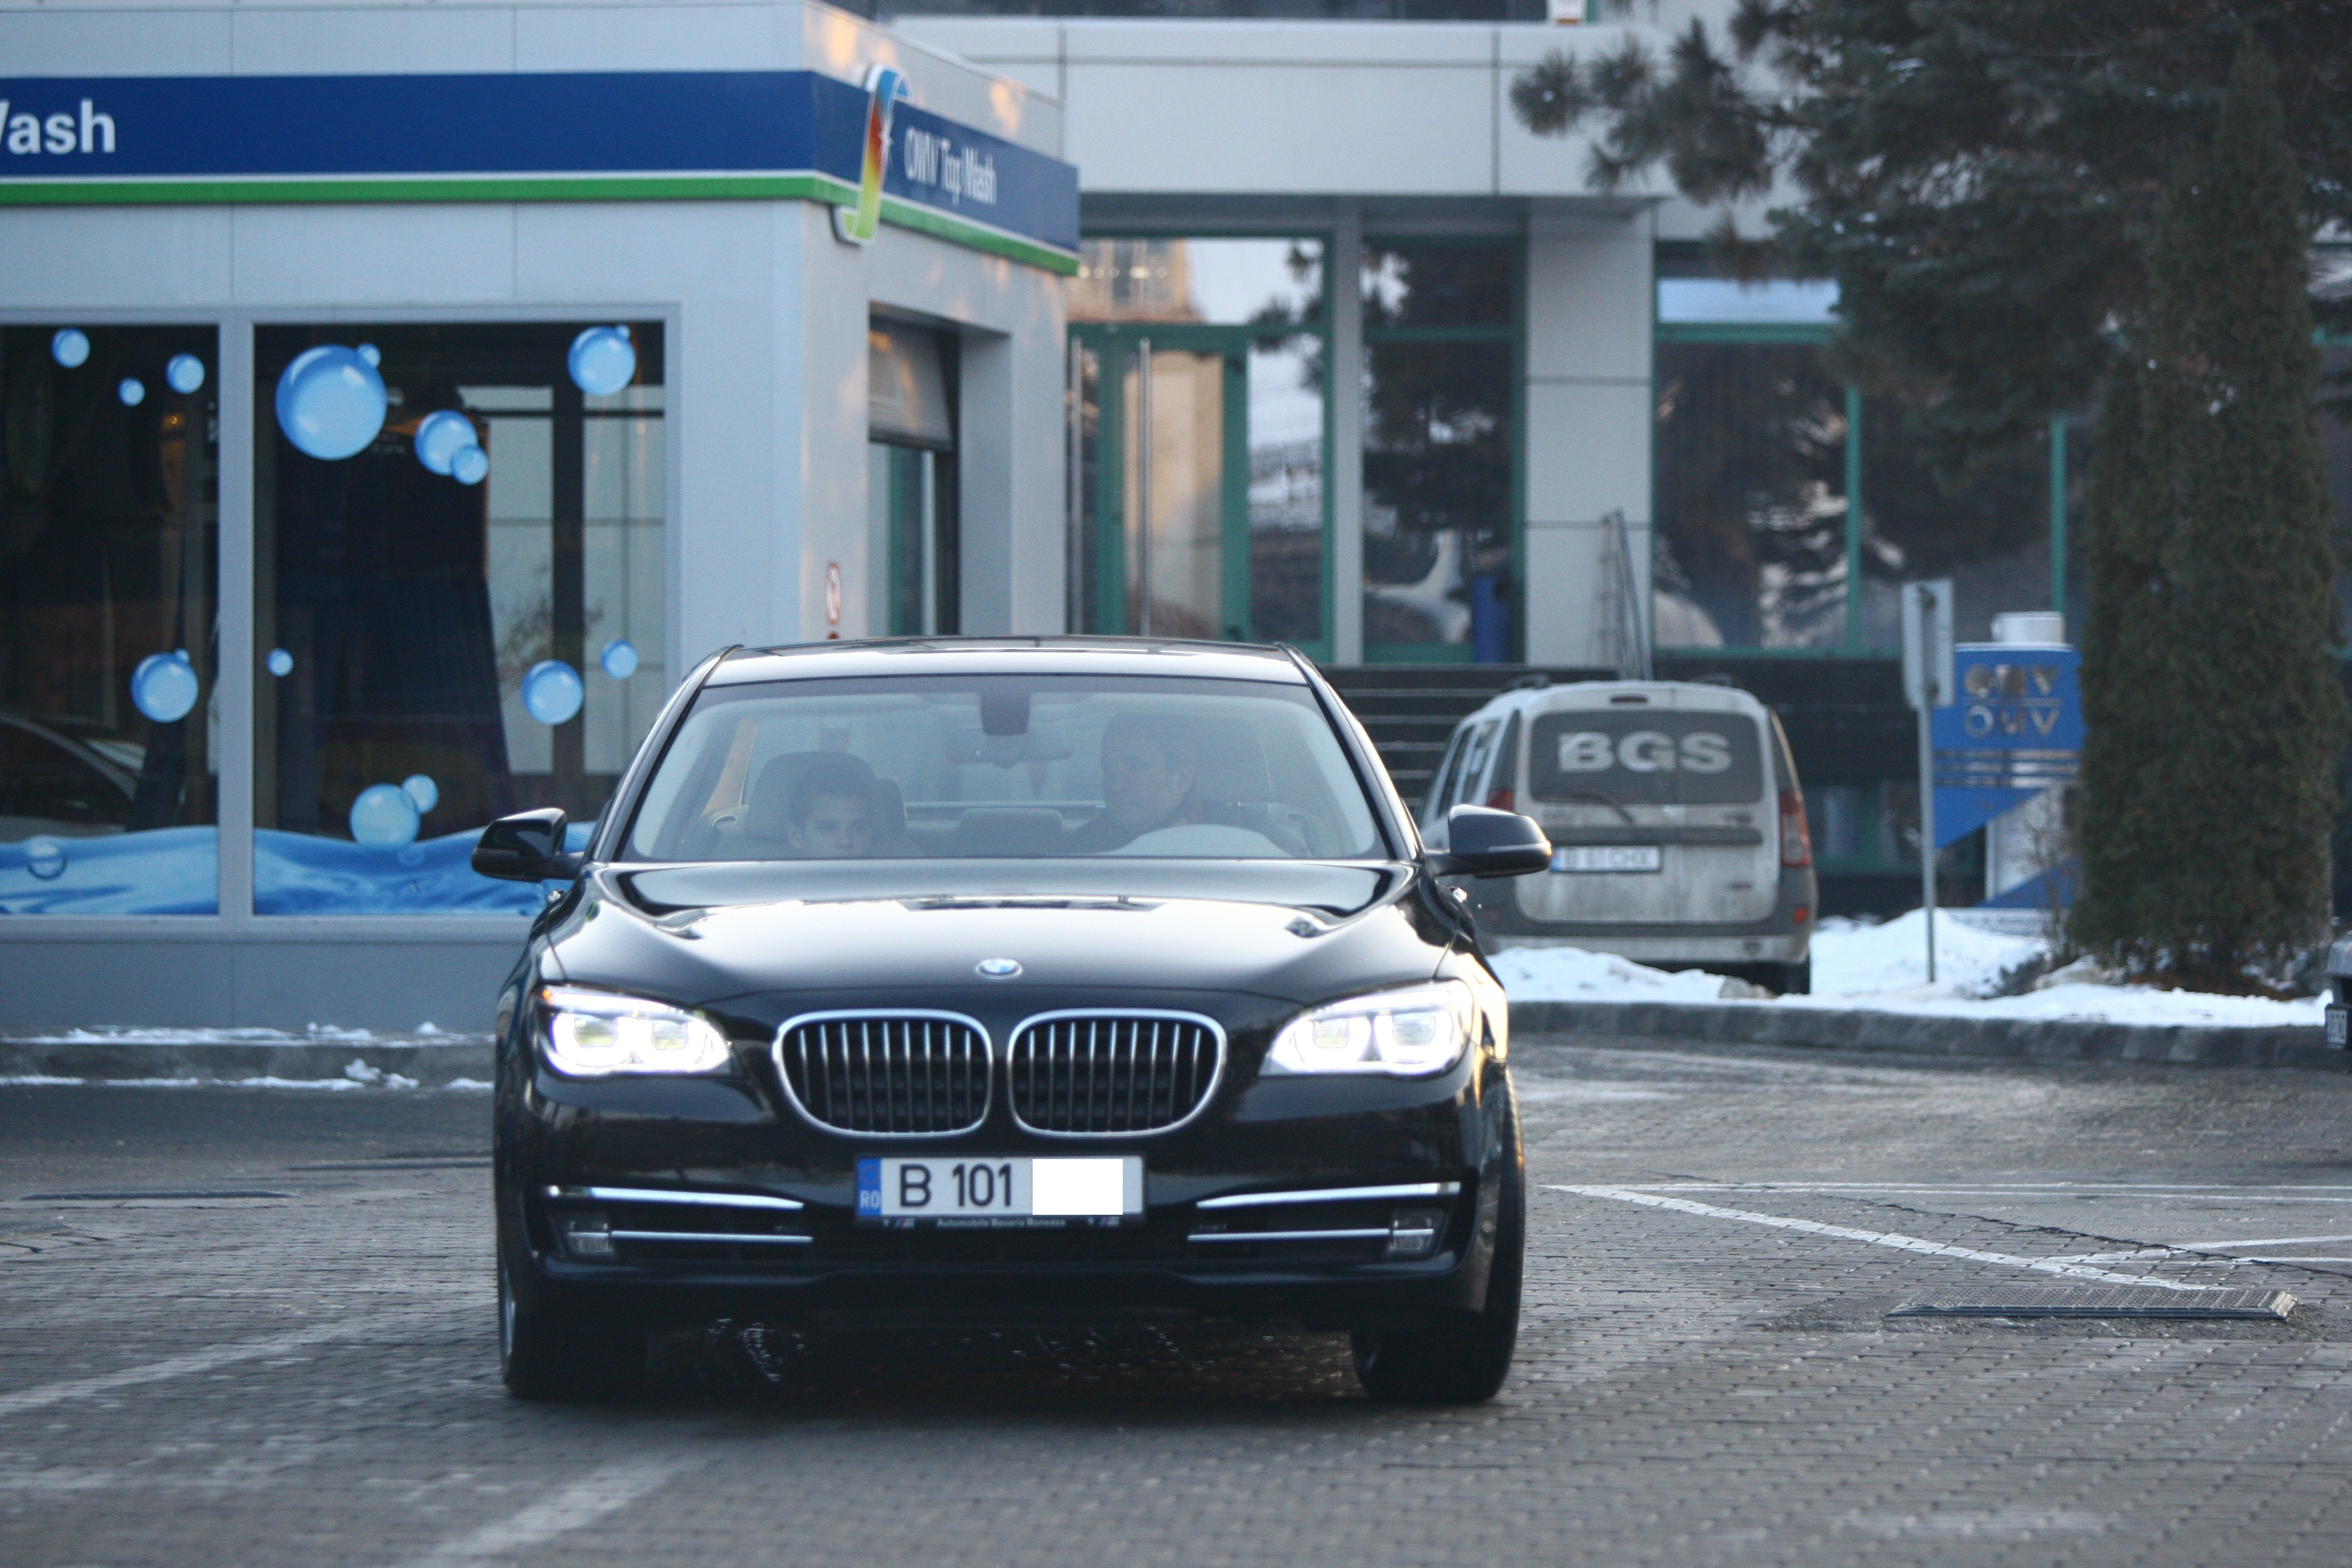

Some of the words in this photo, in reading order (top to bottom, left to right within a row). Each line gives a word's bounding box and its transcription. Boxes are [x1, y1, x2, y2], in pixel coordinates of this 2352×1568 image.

[0, 97, 116, 154] ash
[941, 138, 962, 206] Top
[961, 145, 998, 206] Wash
[1558, 731, 1732, 774] BGS
[860, 1190, 881, 1209] RO
[900, 1163, 932, 1208] B
[952, 1162, 1012, 1207] 101
